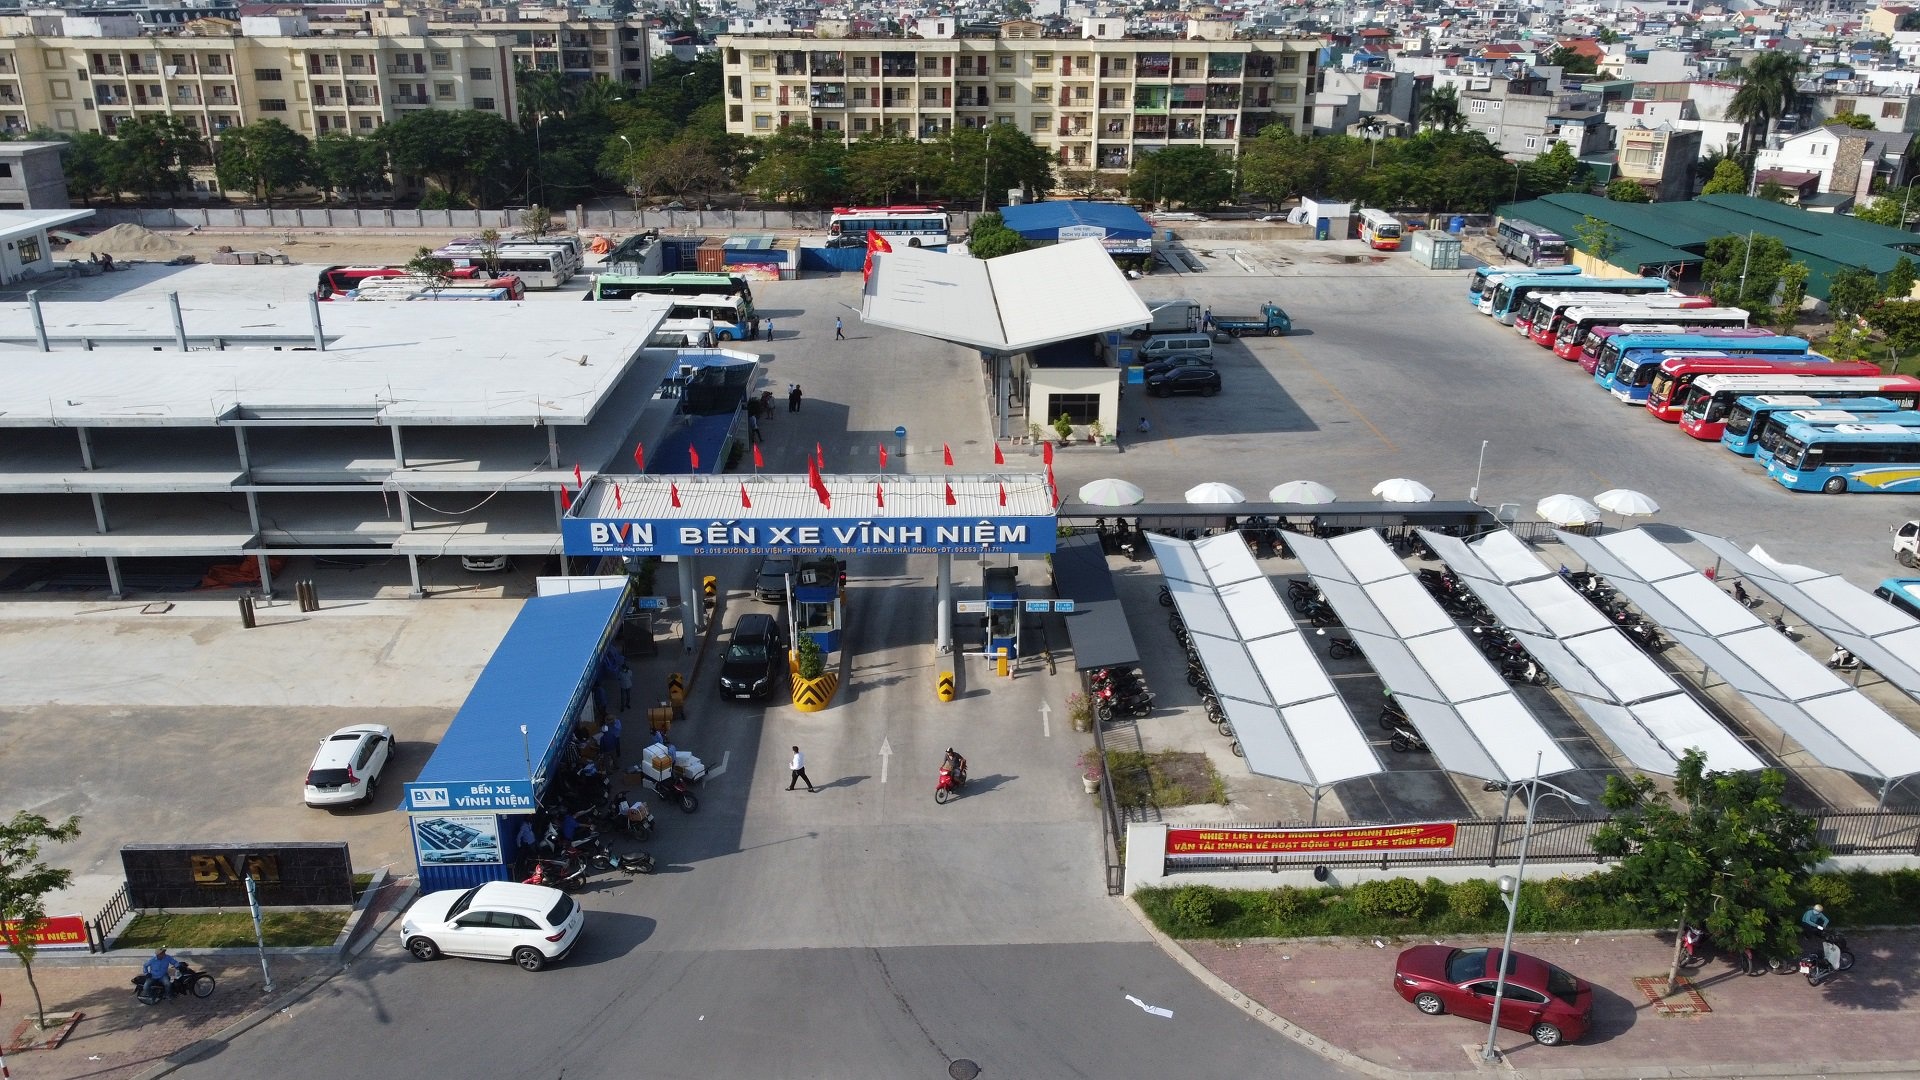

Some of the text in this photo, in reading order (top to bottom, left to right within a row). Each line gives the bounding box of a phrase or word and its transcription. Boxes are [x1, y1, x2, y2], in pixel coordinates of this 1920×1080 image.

[591, 522, 653, 543] BVN
[680, 520, 1026, 547] BẾN XE VĨNH NIỆM
[471, 784, 511, 795] BẾN XE
[455, 794, 530, 807] VĨNH NIỆM
[47, 931, 79, 942] NIỆM
